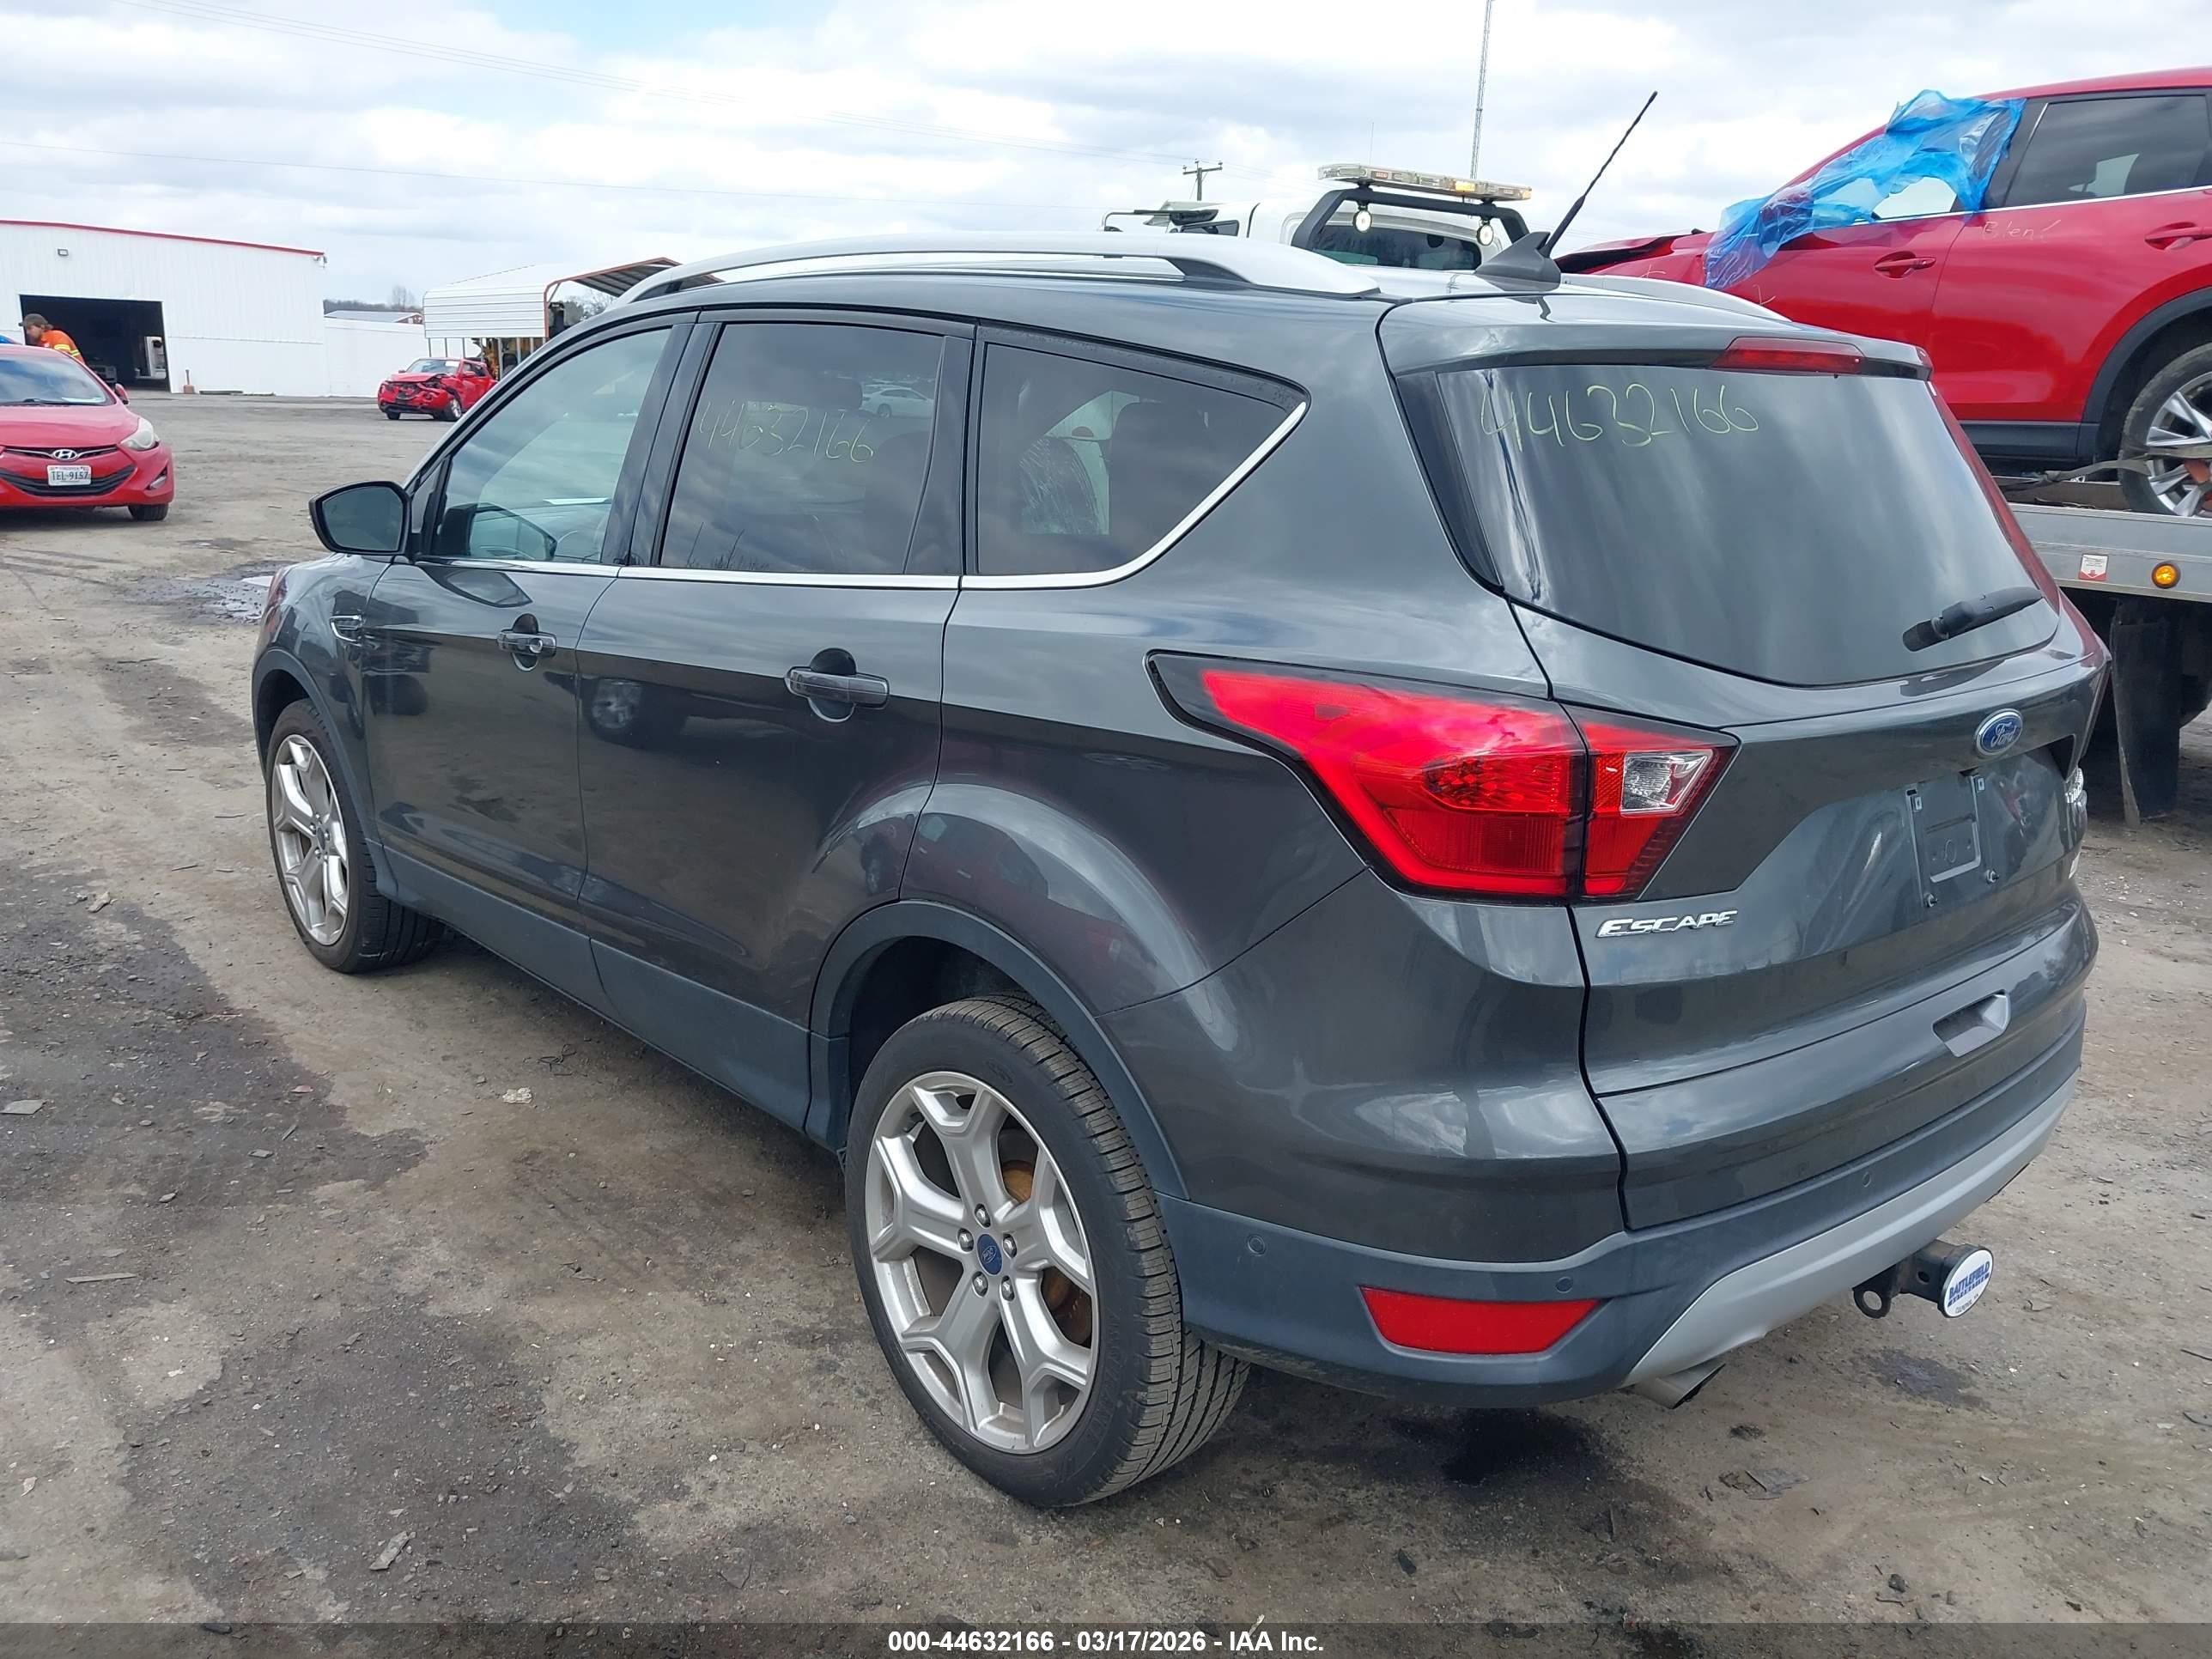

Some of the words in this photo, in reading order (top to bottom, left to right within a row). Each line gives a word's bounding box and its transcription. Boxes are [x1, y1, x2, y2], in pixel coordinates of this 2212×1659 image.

[698, 399, 874, 463] 44632166
[1480, 383, 1759, 453] 44632166
[1595, 910, 1739, 938] ESCAPE
